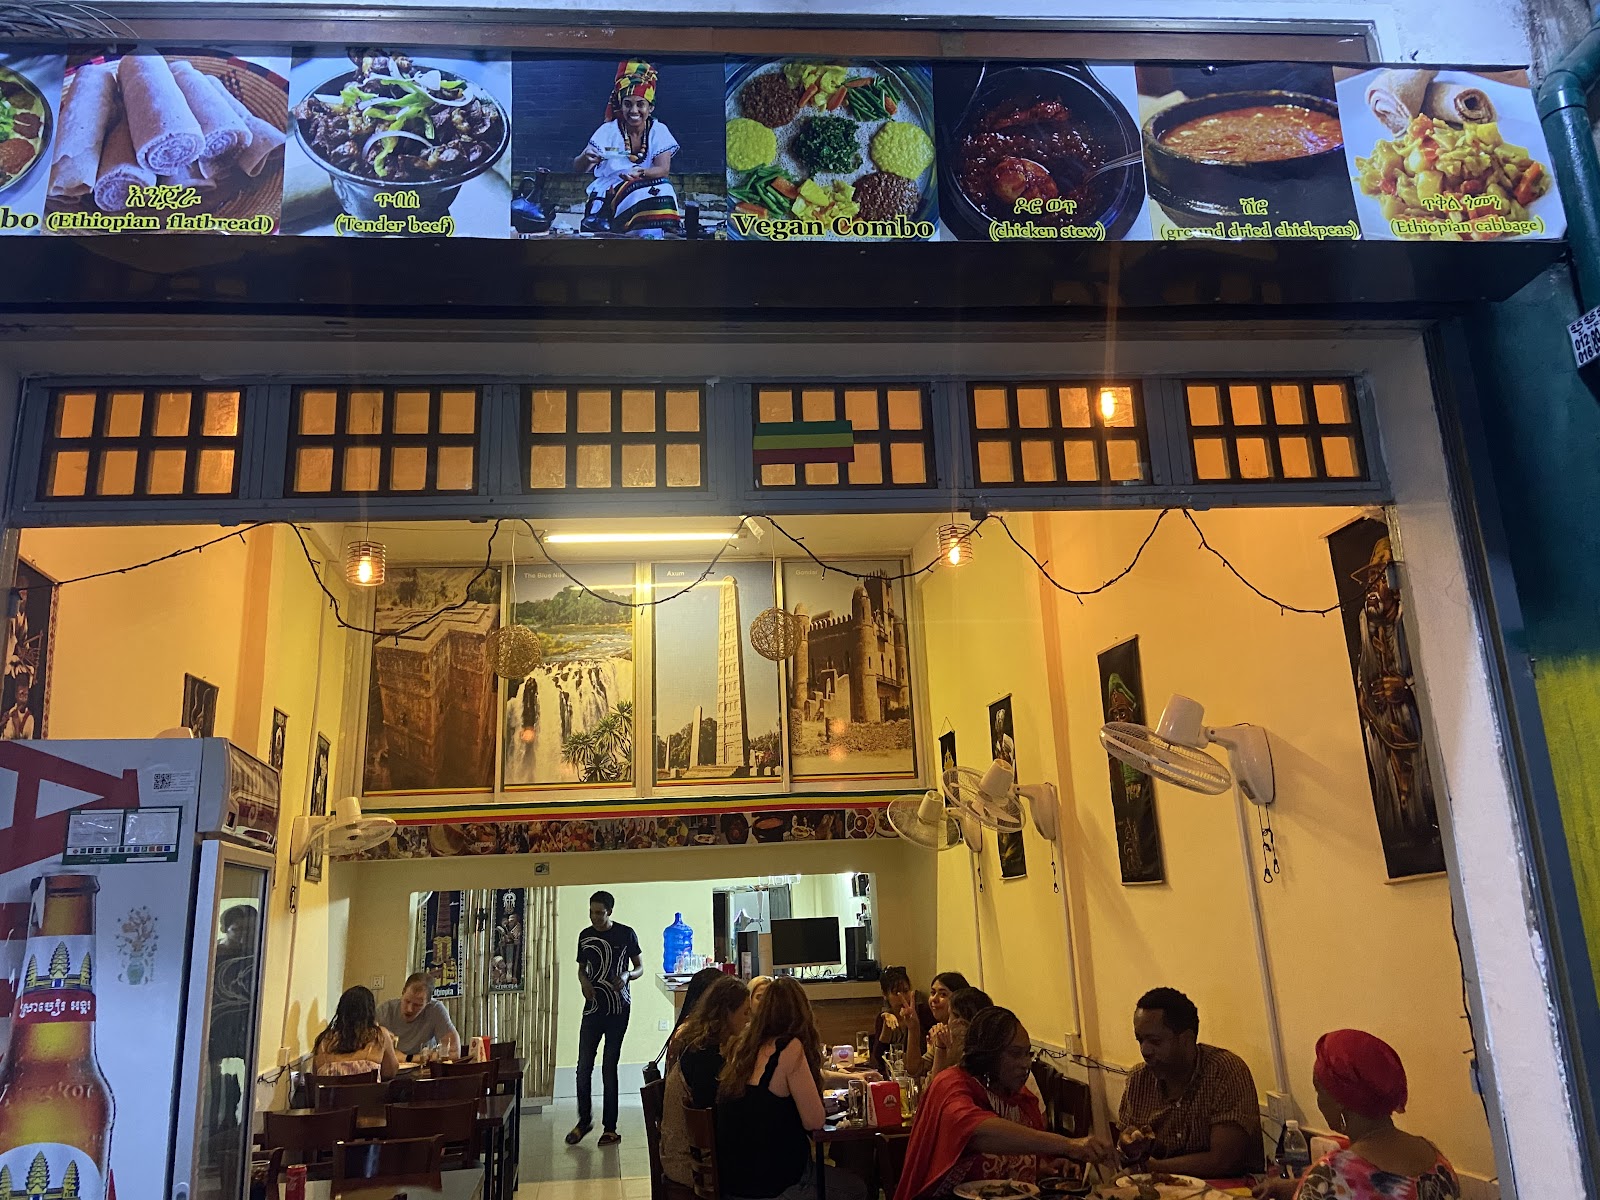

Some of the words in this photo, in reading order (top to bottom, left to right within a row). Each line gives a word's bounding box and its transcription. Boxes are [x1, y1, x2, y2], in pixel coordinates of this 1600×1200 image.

[126, 184, 201, 209] እንጀራ
[1014, 198, 1043, 214] ዶሮ
[47, 212, 160, 233] (Ethiopian
[166, 212, 274, 233] flatbread)
[334, 214, 405, 236] (Tender
[409, 214, 455, 236] beef)
[731, 213, 823, 240] Vegan
[832, 213, 935, 239] Combo
[989, 221, 1059, 241] (chicken
[1061, 221, 1106, 241] stew)
[1160, 221, 1225, 240] (grond
[1228, 222, 1273, 238] dried
[1275, 220, 1360, 241] chickpeas)
[1390, 218, 1471, 237] (Ethiopian
[1473, 215, 1545, 234] cabbage)
[1575, 333, 1590, 351] 012
[1579, 346, 1593, 363] 016
